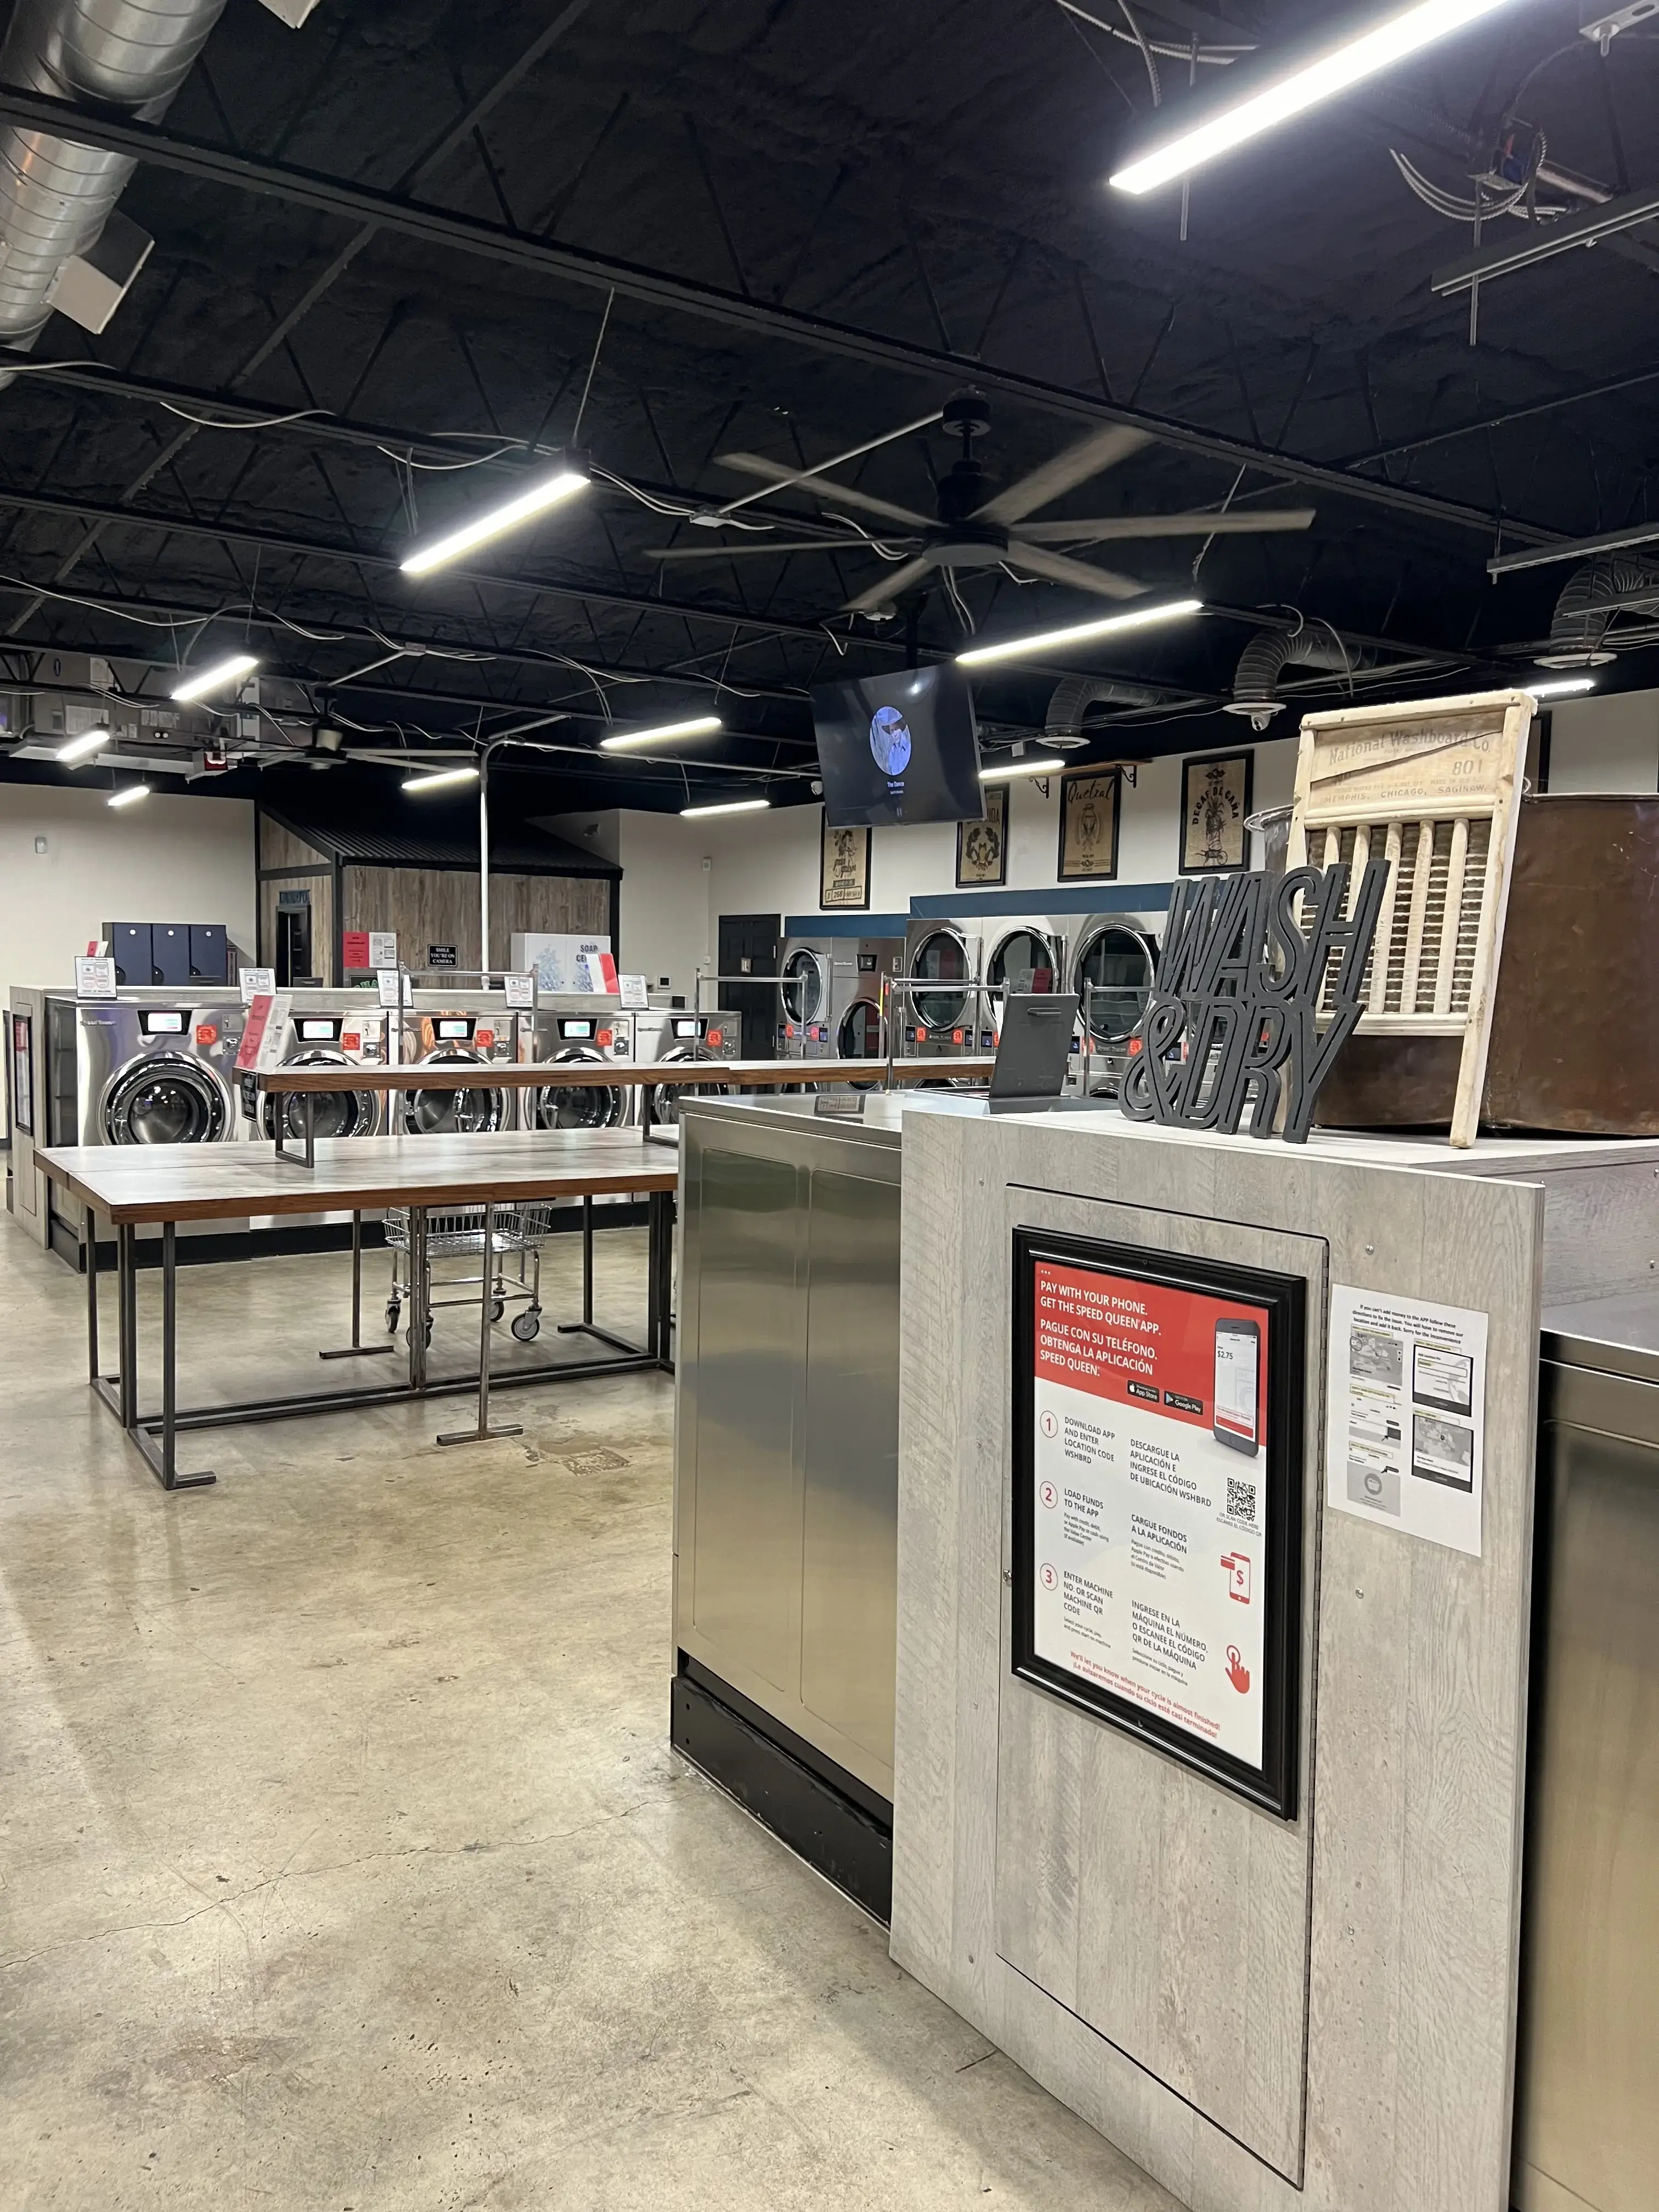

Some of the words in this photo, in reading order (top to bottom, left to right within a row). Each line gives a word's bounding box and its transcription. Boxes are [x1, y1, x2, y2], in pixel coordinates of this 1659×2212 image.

[1329, 735, 1385, 766] National
[1389, 729, 1469, 747] Washboard
[1192, 790, 1210, 825] DECAF
[1212, 786, 1224, 797] DE
[1381, 788, 1427, 798] CHICAGO,
[1154, 858, 1392, 1009] WASH
[1041, 1280, 1058, 1294] PAY
[1058, 1284, 1081, 1300] WITH
[1084, 1290, 1109, 1306] YOUR
[1111, 1297, 1148, 1315] PHONE.
[1041, 1296, 1057, 1309] GET
[1058, 1300, 1075, 1313] THE
[1076, 1305, 1103, 1321] SPEED
[1140, 1321, 1161, 1335] APP.
[1353, 1317, 1370, 1325] location
[1041, 1319, 1069, 1335] PAGUE
[1070, 1327, 1091, 1341] CON
[1092, 1333, 1104, 1345] SU
[1105, 1336, 1158, 1360] TELÉFONO.
[1040, 1334, 1082, 1355] OBTENGA
[1083, 1346, 1094, 1359] LA
[1096, 1350, 1153, 1375] APLICACIÓN
[1040, 1350, 1065, 1366] SPEED
[1136, 1388, 1145, 1397] App
[1146, 1390, 1158, 1400] Store
[1175, 1399, 1192, 1410] Google
[1191, 1402, 1201, 1414] Play
[1046, 1418, 1051, 1431] 1
[1064, 1417, 1102, 1435] DOWNLOAD
[1102, 1430, 1115, 1440] APP
[1064, 1427, 1079, 1437] AND
[1080, 1432, 1099, 1446] ENTER
[1064, 1437, 1097, 1455] LOCATION
[1097, 1449, 1115, 1462] CODE
[1064, 1448, 1092, 1464] WSHBRD
[1130, 1438, 1170, 1459] DESCARGUE
[1171, 1452, 1180, 1462] LA
[1130, 1450, 1171, 1470] APLICACIÓN
[1172, 1464, 1177, 1472] E
[1130, 1461, 1158, 1477] INGRESE
[1159, 1471, 1167, 1481] EL
[1168, 1474, 1197, 1491] CÓDIGO
[1045, 1487, 1052, 1502] 2
[1064, 1488, 1081, 1500] LOAD
[1082, 1495, 1104, 1509] FUNDS
[1130, 1472, 1139, 1482] DE
[1140, 1476, 1178, 1496] UBICACIÓN
[1179, 1489, 1212, 1507] WSHBRD
[1064, 1499, 1073, 1508] TO
[1074, 1502, 1086, 1513] THE
[1086, 1508, 1099, 1517] APP
[1131, 1514, 1157, 1531] CARGUE
[1159, 1525, 1187, 1543] FONDOS
[1131, 1525, 1137, 1533] A
[1137, 1527, 1146, 1538] LA
[1147, 1531, 1187, 1554] APLICACIÓN
[1046, 1570, 1052, 1584] 3
[1064, 1571, 1083, 1585] ENTER
[1084, 1579, 1113, 1599] MACHINE
[1064, 1581, 1075, 1592] NO.
[1076, 1587, 1086, 1597] OR
[1086, 1591, 1103, 1605] SCAN
[1064, 1592, 1092, 1611] MACHINE
[1093, 1605, 1103, 1616] QR
[1064, 1602, 1080, 1616] CODE
[1132, 1600, 1159, 1618] INGRESE
[1161, 1612, 1170, 1624] EN
[1171, 1618, 1180, 1628] LA
[1132, 1611, 1165, 1633] MÁQUINA
[1166, 1627, 1174, 1637] EL
[1132, 1622, 1138, 1630] O
[1139, 1625, 1167, 1645] ESCANEE
[1169, 1639, 1176, 1649] EL
[1178, 1643, 1205, 1662] CÓDIGO
[1132, 1633, 1142, 1644] QR
[1143, 1638, 1152, 1649] DE
[1153, 1643, 1162, 1654] LA
[1163, 1647, 1197, 1670] MÁQUINA
[1070, 1650, 1083, 1662] We'll
[1093, 1662, 1103, 1671] you
[1104, 1666, 1119, 1679] know
[1120, 1676, 1136, 1688] when
[1137, 1684, 1150, 1695] your
[1152, 1691, 1166, 1702] cycle
[1167, 1697, 1172, 1706] is
[1173, 1702, 1193, 1717] almost
[1194, 1711, 1220, 1731] finished!
[1082, 1666, 1113, 1685] avisaremos
[1114, 1682, 1135, 1696] cuando
[1144, 1696, 1157, 1707] ciclo
[1158, 1703, 1170, 1714] esté
[1171, 1710, 1183, 1721] casi
[1184, 1716, 1217, 1739] terminado!
